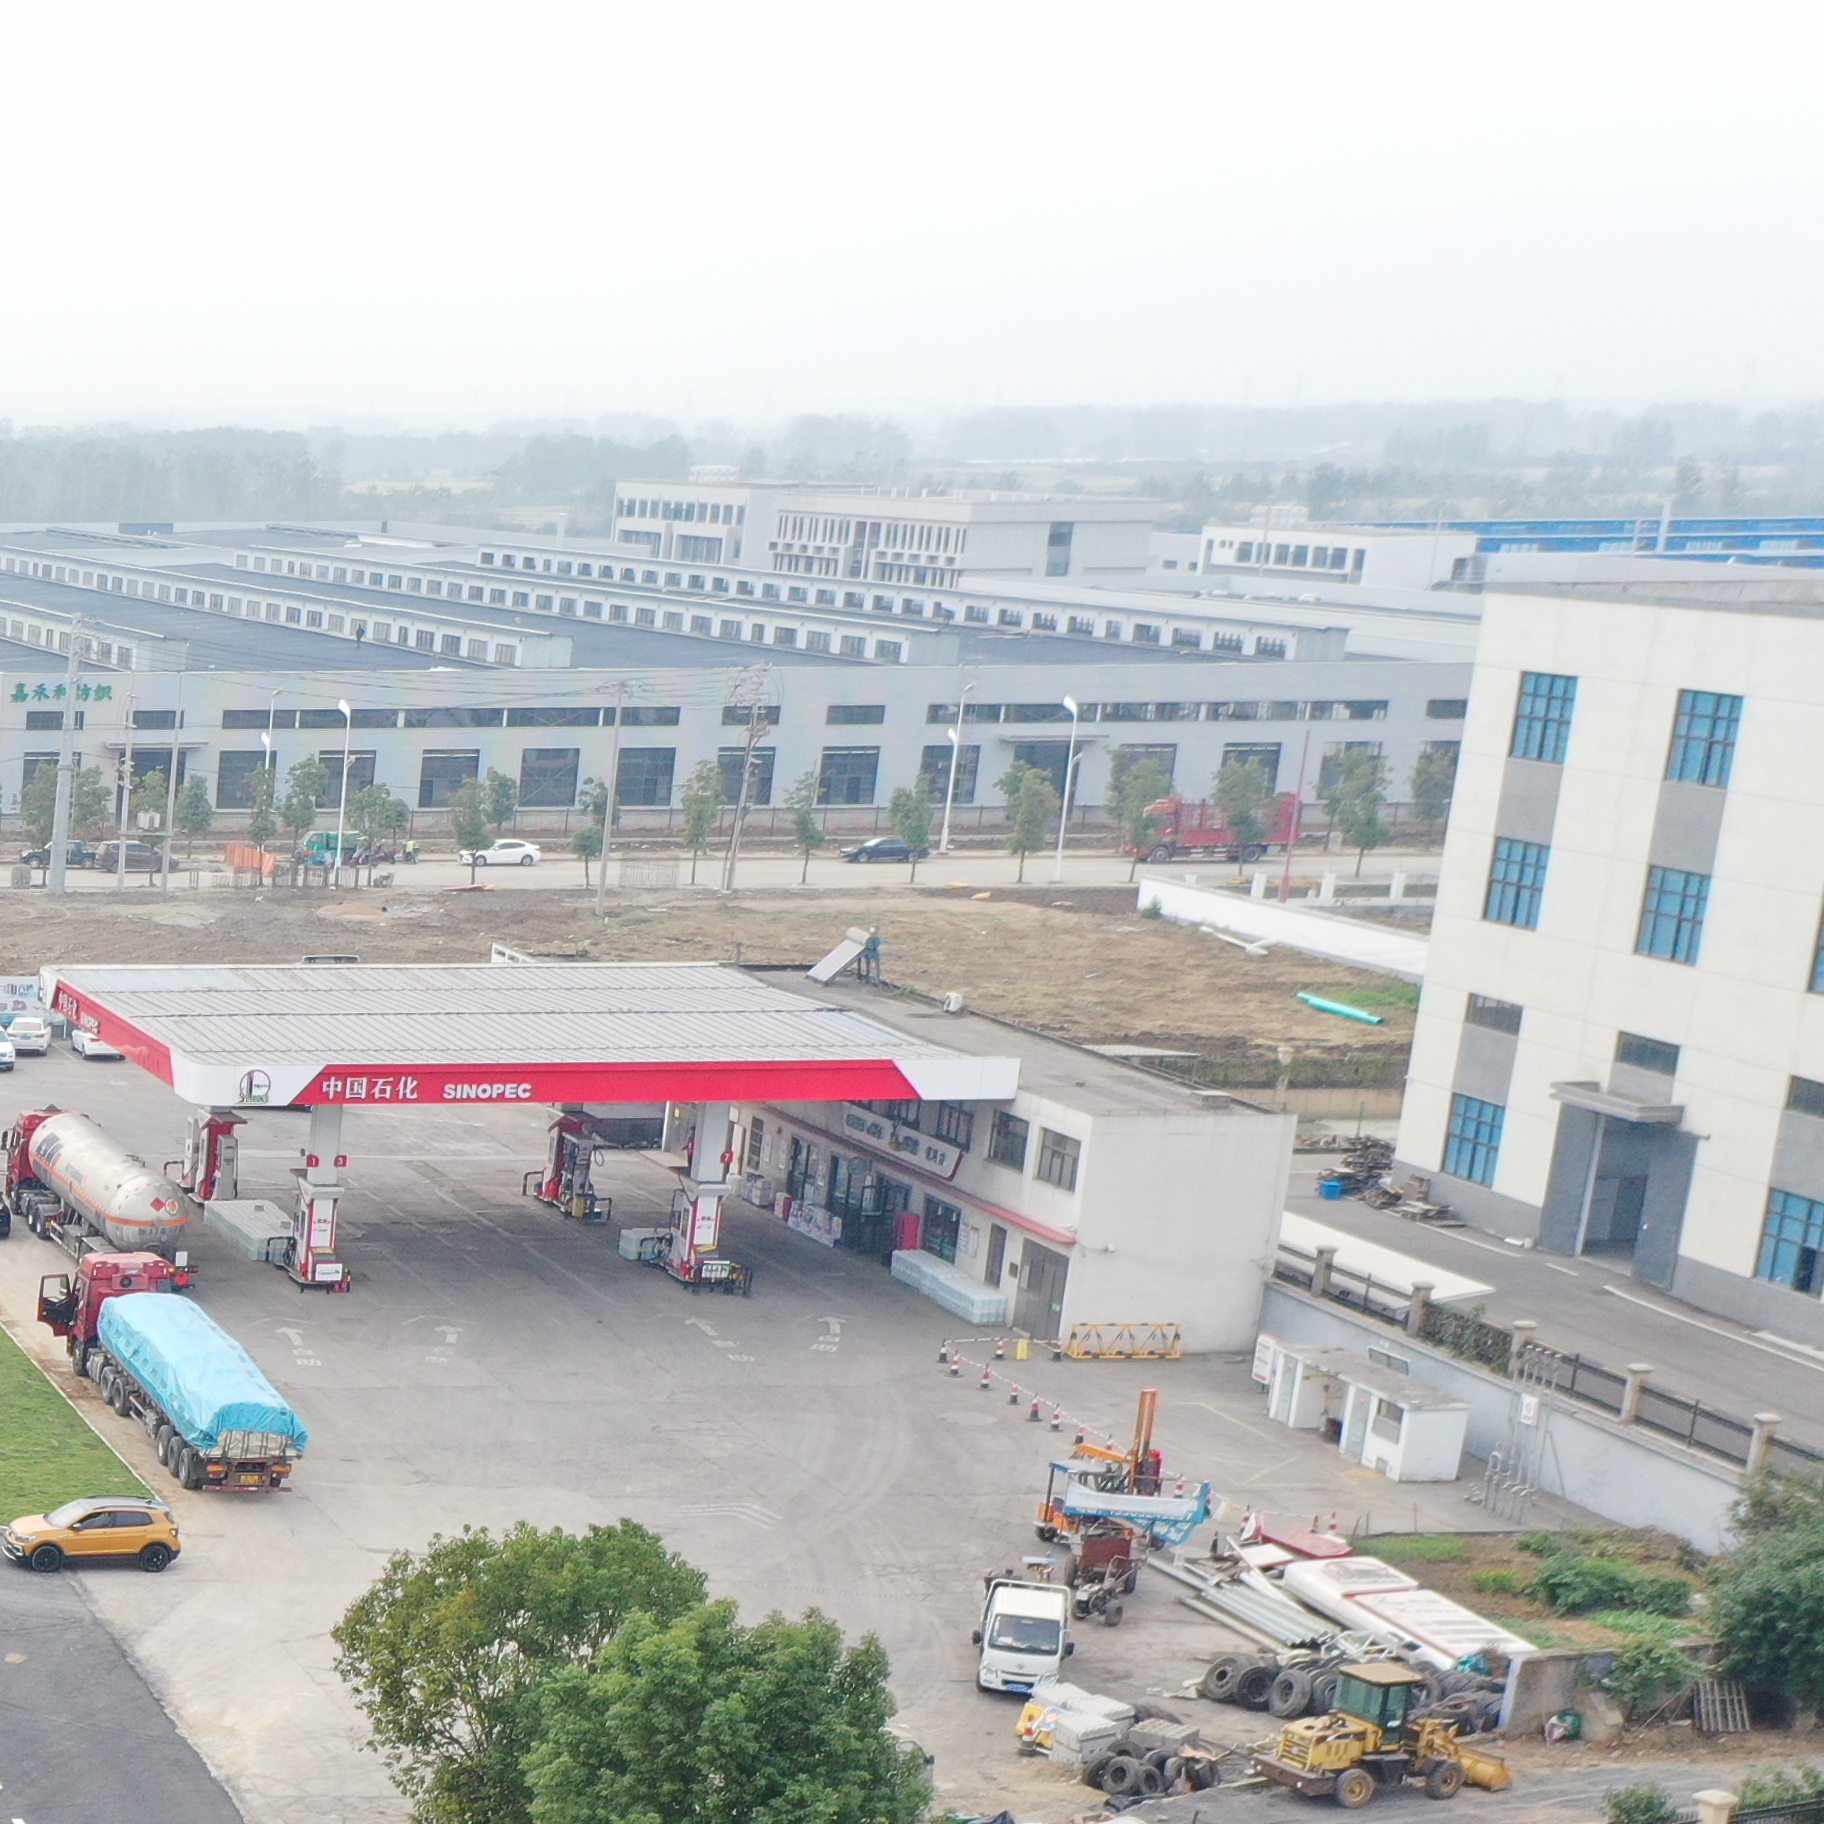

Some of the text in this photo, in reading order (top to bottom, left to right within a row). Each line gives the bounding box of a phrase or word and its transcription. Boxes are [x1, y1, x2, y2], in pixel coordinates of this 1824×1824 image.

[321, 1076, 533, 1100] 中国石化 SINOPEC
